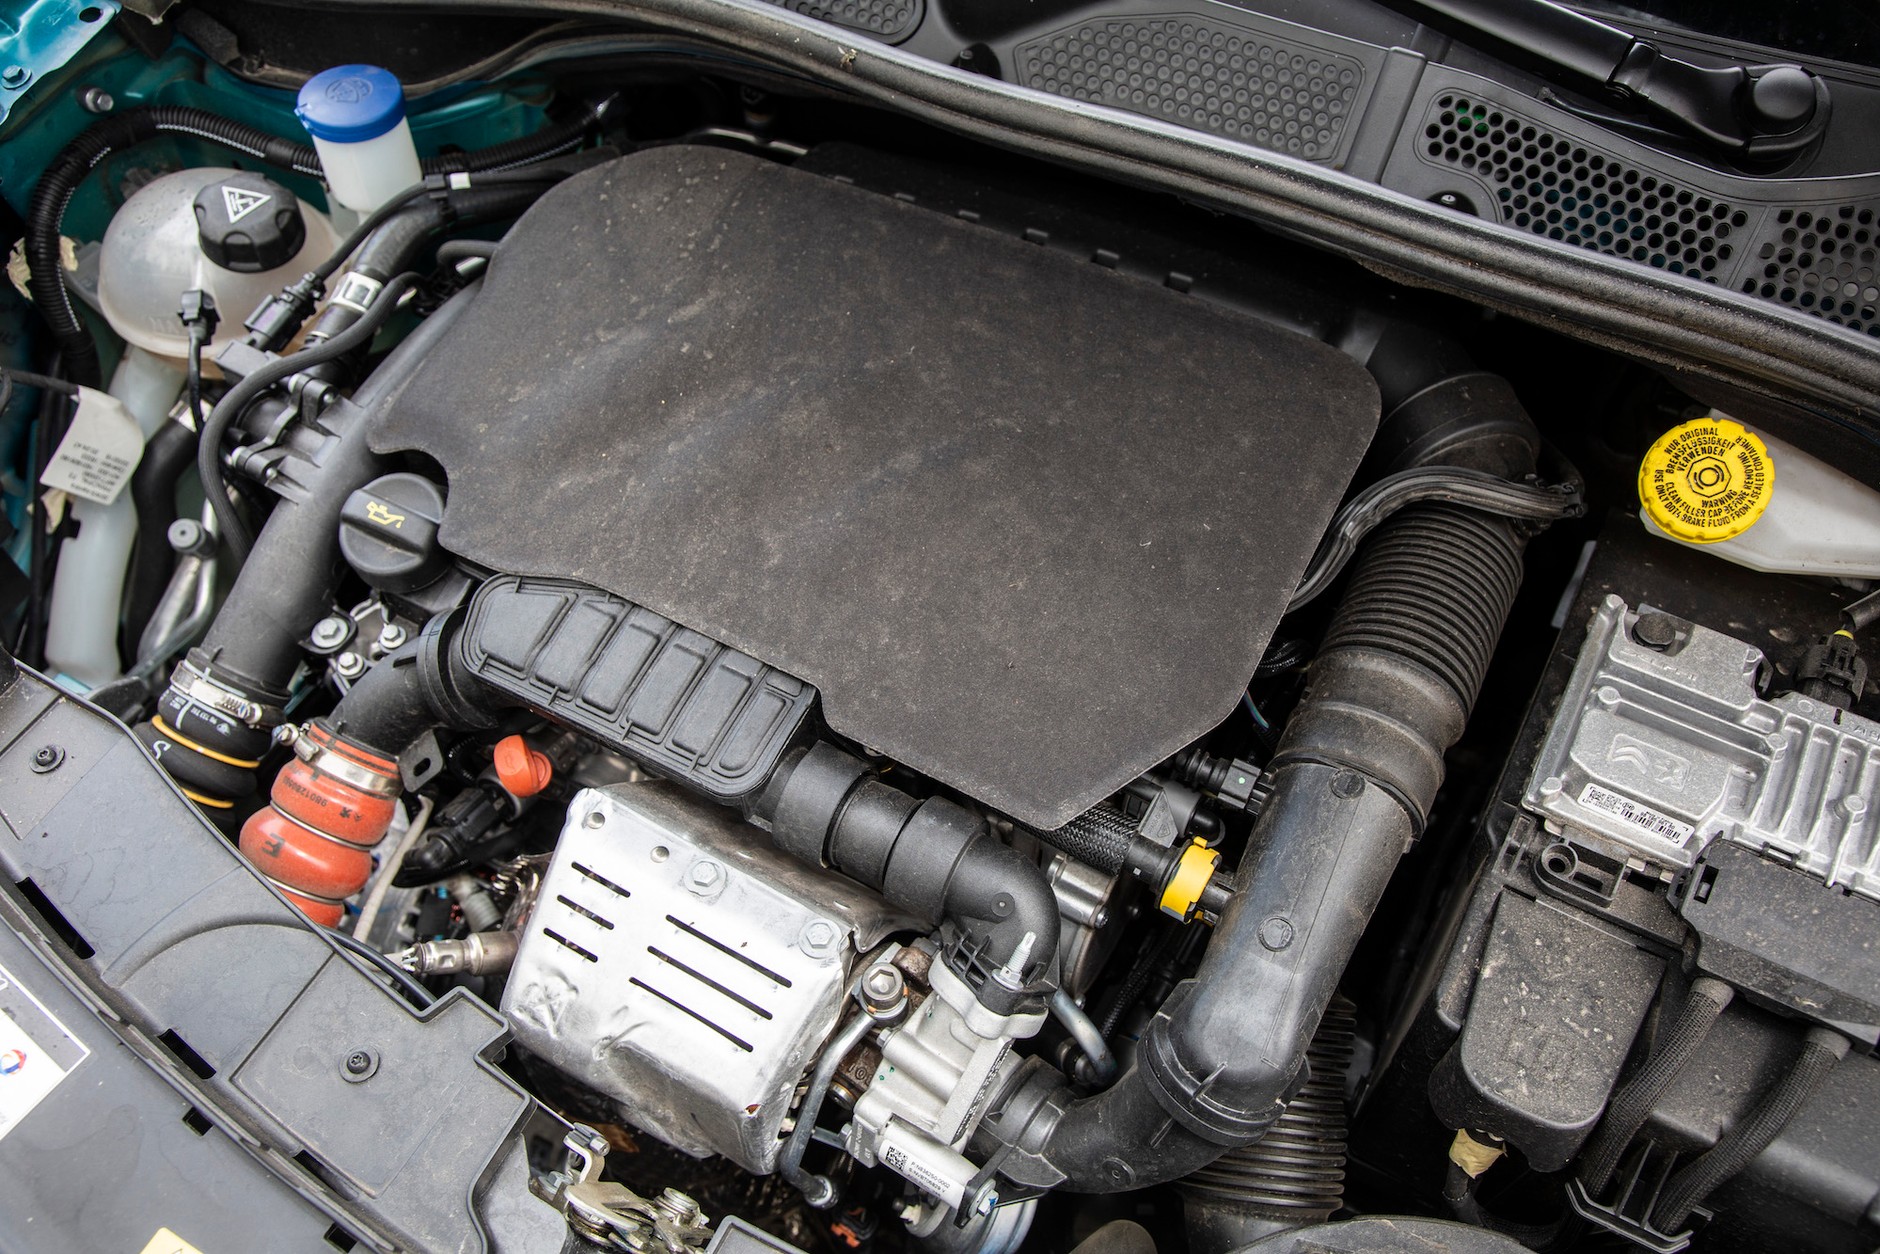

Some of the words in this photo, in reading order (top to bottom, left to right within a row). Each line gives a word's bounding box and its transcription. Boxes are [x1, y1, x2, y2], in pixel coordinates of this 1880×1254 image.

[1664, 438, 1681, 455] NUR
[1680, 427, 1719, 441] ORIGINAL
[1676, 446, 1726, 472] VERWENDEN
[1735, 435, 1764, 472] CONTAINER
[1655, 469, 1664, 483] USE
[1665, 481, 1683, 508] CLEAN
[1679, 501, 1706, 518] FILLER
[1707, 508, 1723, 518] CAP
[1724, 489, 1750, 514] BEFORE
[1737, 451, 1754, 491] REMOVING
[1655, 485, 1669, 503] ONLY
[1750, 472, 1765, 500] SEALED
[1701, 489, 1738, 509] WARNING
[1747, 499, 1756, 507] A
[1681, 513, 1705, 527] BRAKE
[1707, 516, 1731, 528] FLUID
[1731, 504, 1751, 521] FROM
